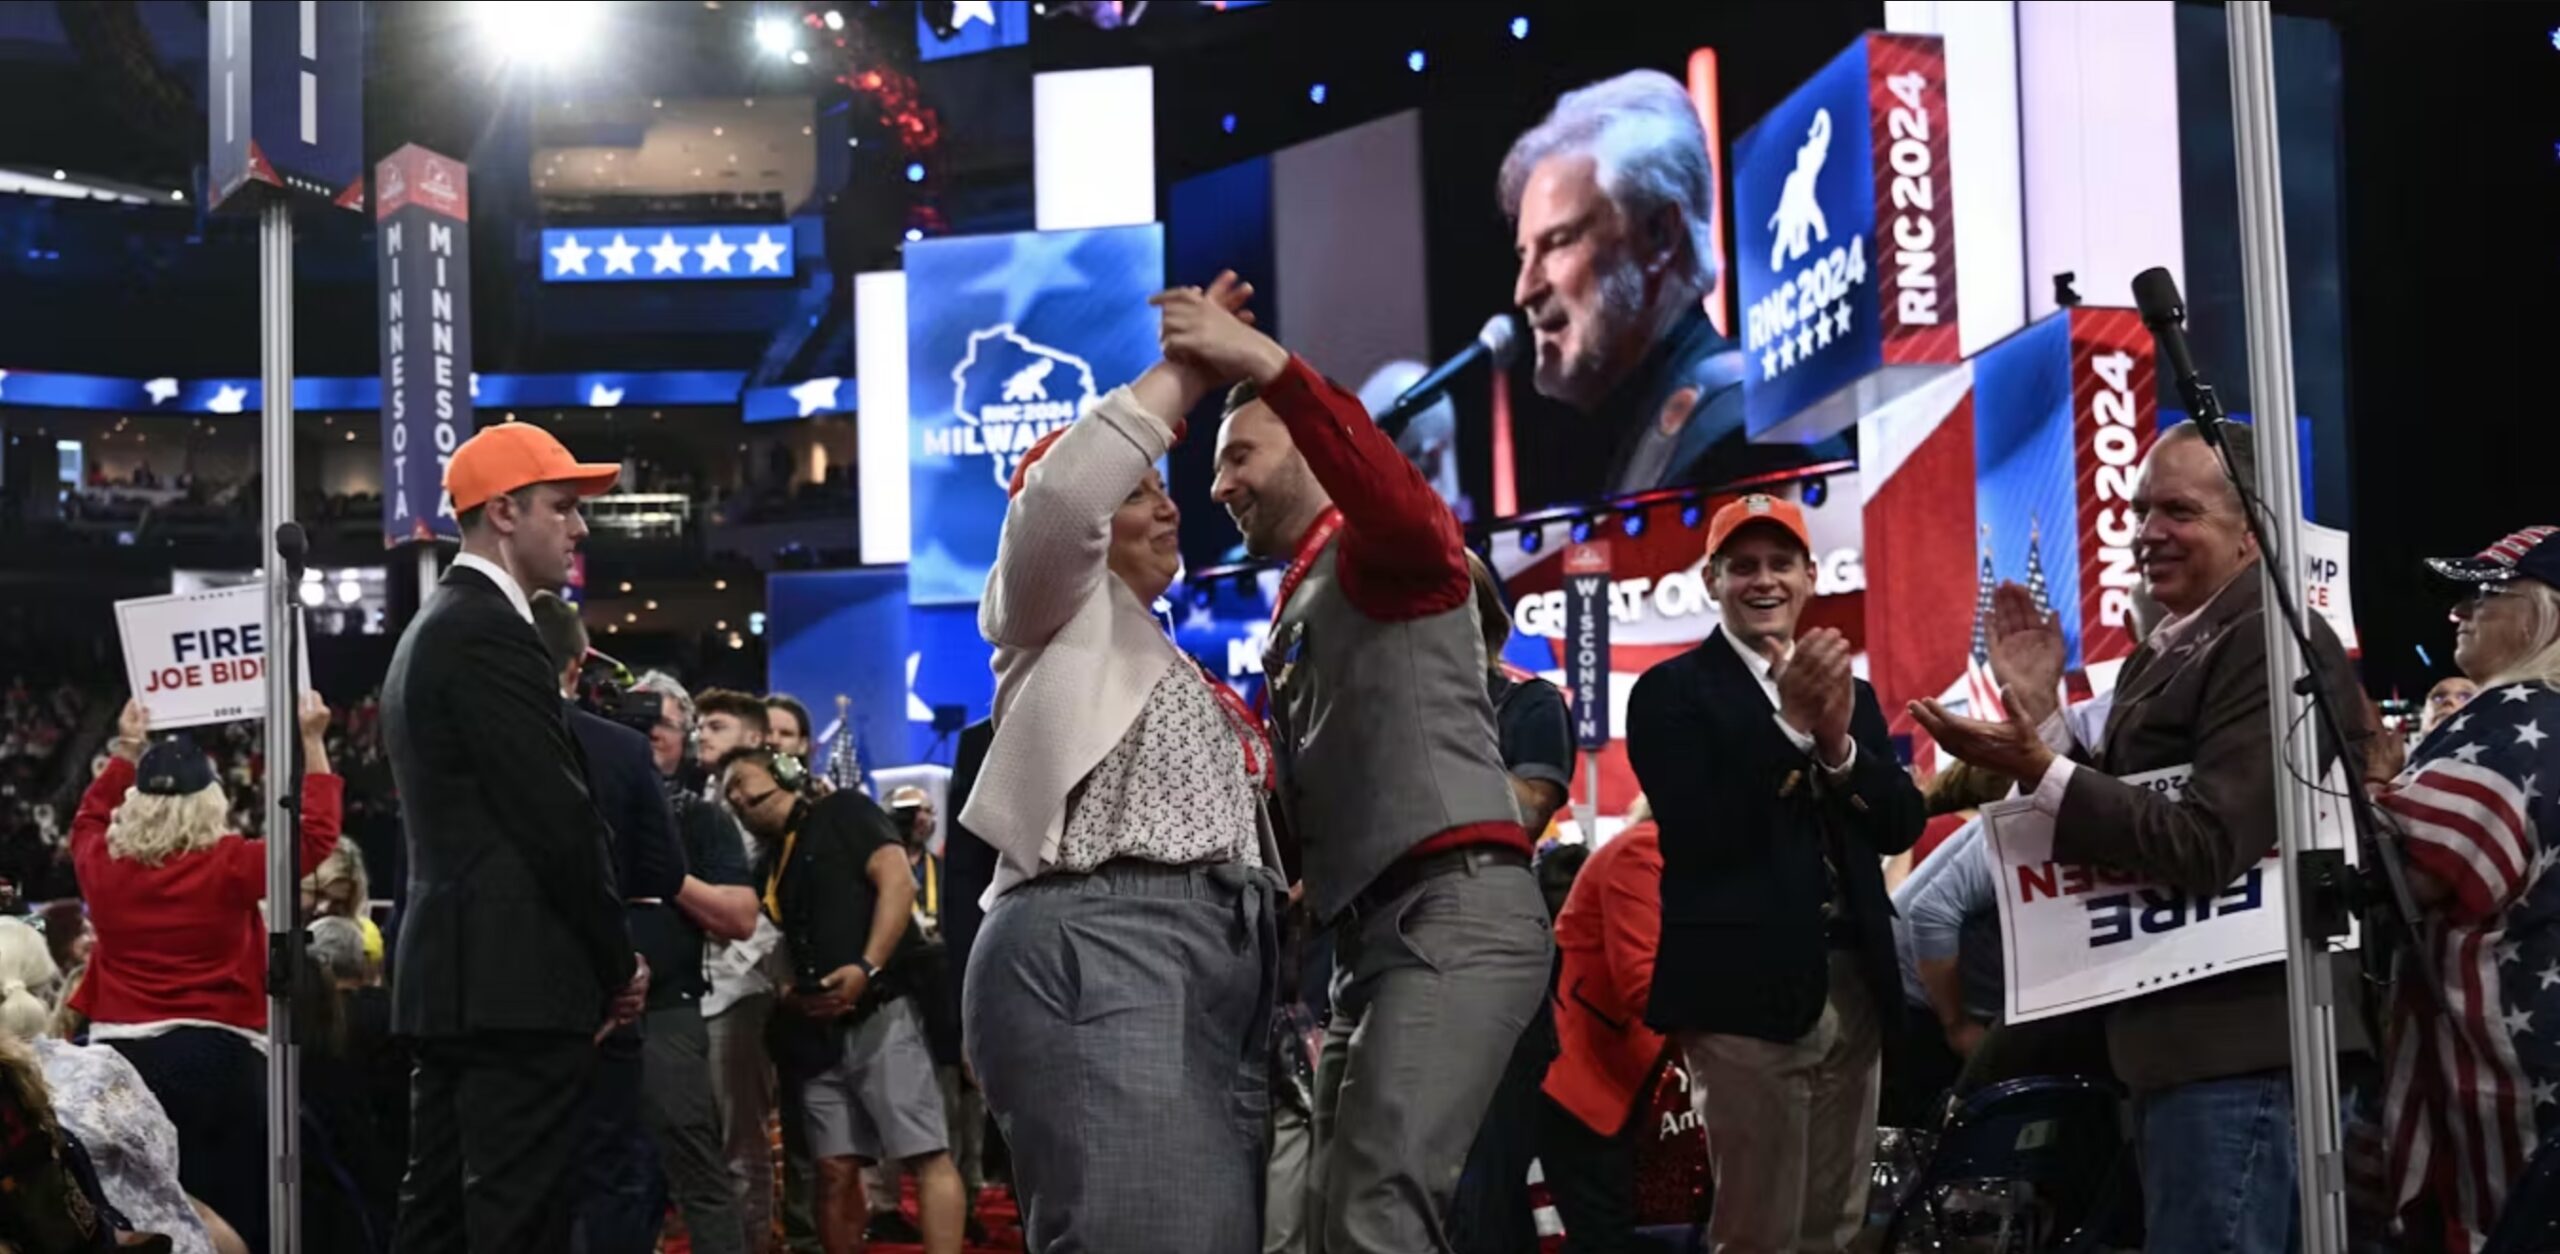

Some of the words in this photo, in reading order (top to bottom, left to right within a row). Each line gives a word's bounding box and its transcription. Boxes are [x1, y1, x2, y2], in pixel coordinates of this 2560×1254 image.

[1887, 71, 1935, 210] 2024
[1748, 282, 1797, 352] RNC
[1796, 235, 1867, 323] 2024
[1893, 215, 1939, 326] RNC
[388, 222, 409, 520] MINNESOTA
[2092, 350, 2138, 502] 2024
[172, 623, 264, 663] FIRE
[1514, 577, 1651, 637] GRAT
[1575, 577, 1599, 738] WISCONSIN
[145, 665, 203, 693] JOE
[214, 705, 243, 718] 2024
